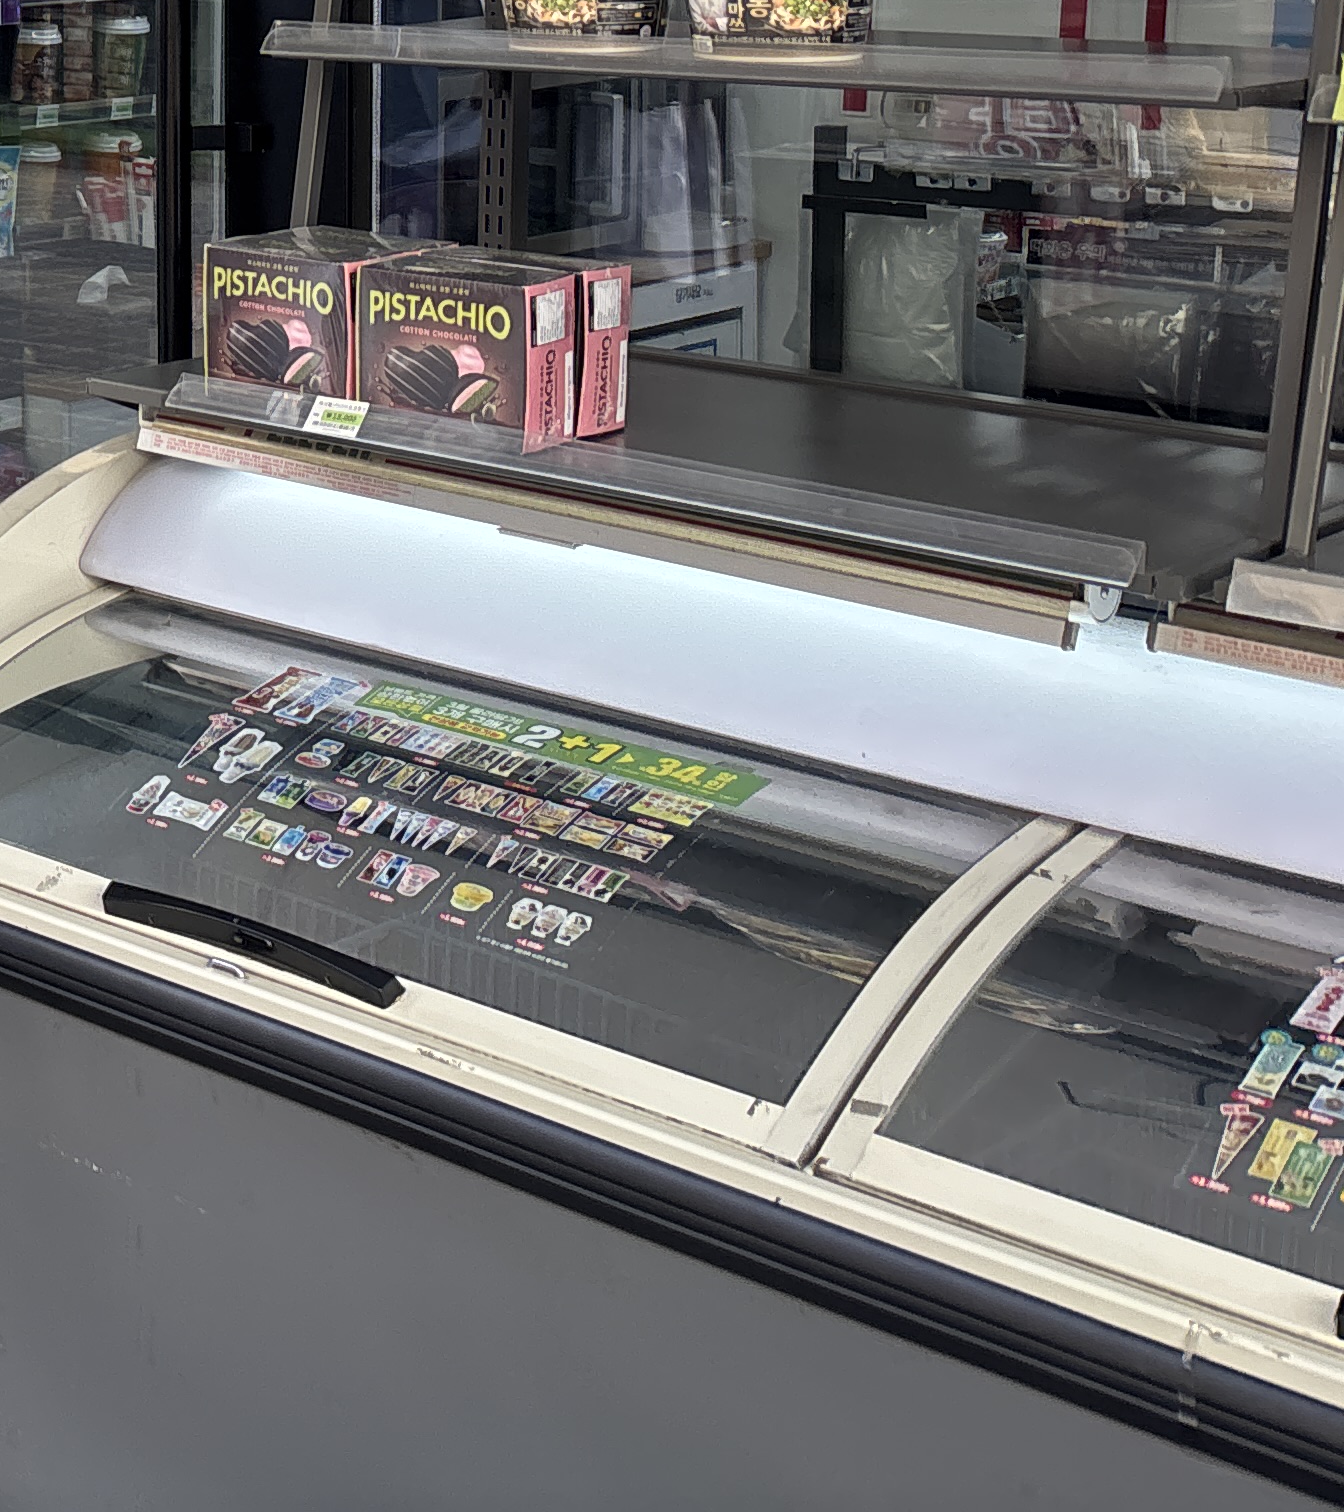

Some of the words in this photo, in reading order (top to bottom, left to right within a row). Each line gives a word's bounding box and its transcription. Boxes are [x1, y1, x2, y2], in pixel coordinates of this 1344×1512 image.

[213, 265, 334, 316] PISTACHIO
[239, 299, 266, 312] COTTON
[267, 303, 306, 318] CHOCOLATE
[368, 288, 512, 342] PISTACHIO
[399, 324, 432, 339] COTTON
[433, 328, 479, 344] CHOCOLATE
[511, 723, 624, 765] 2+1
